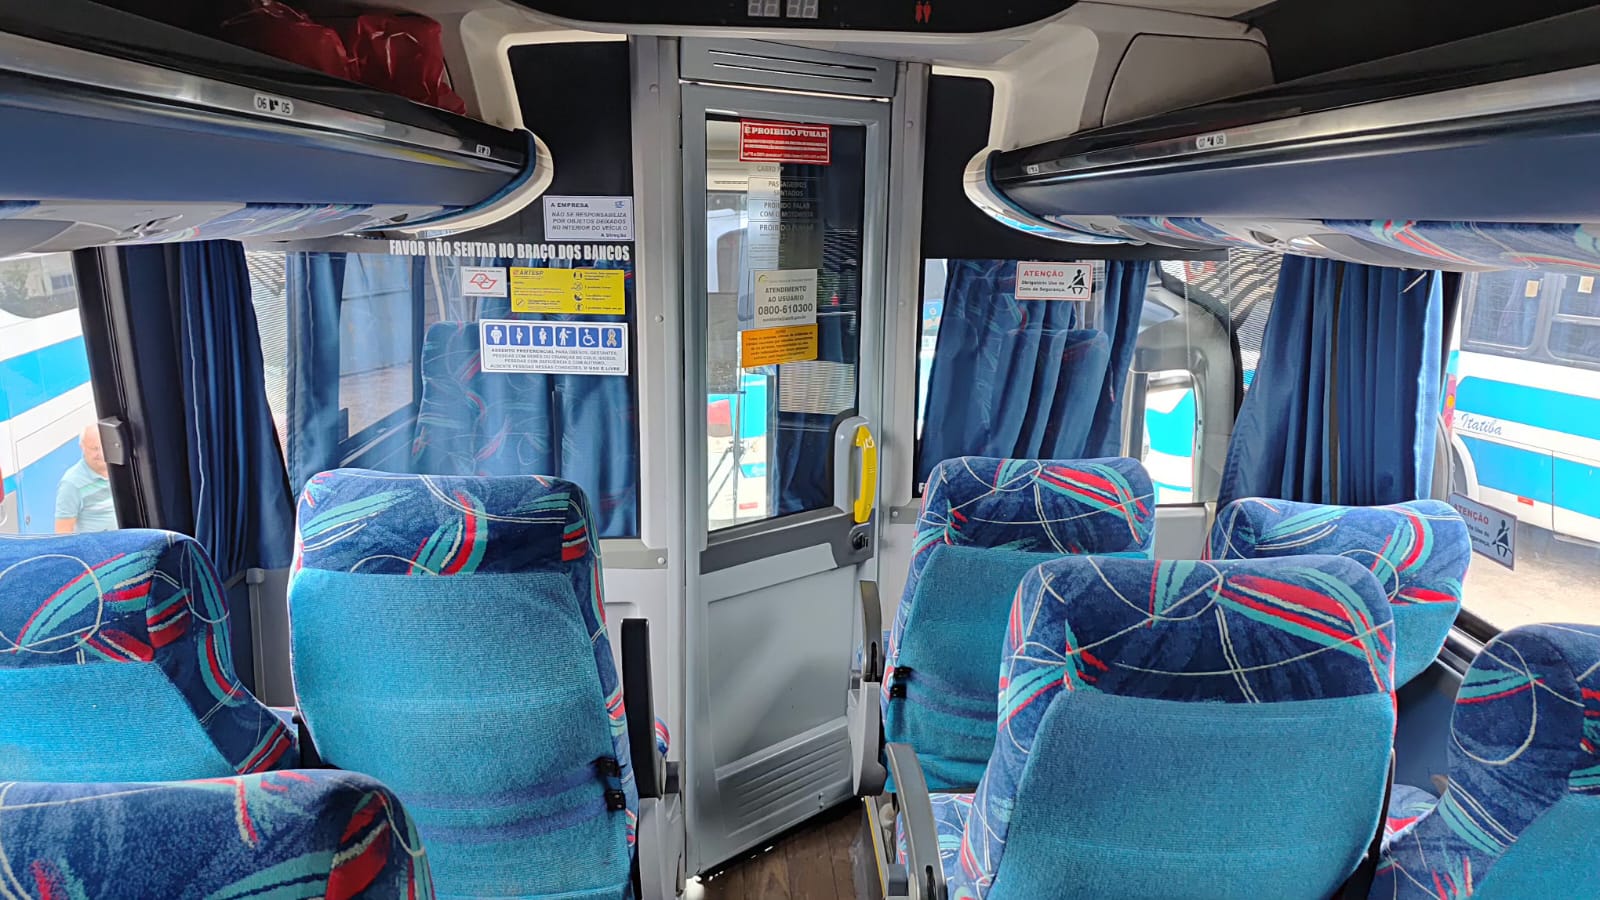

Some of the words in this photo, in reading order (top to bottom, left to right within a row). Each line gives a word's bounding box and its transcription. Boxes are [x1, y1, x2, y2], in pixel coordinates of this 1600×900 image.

[257, 97, 267, 109] 06
[744, 125, 751, 134] É
[752, 127, 796, 136] PROIBIDO
[797, 129, 827, 137] FUMAR
[389, 240, 426, 256] FAVOR
[428, 238, 451, 257] NÃO
[453, 241, 497, 258] SENTAR
[499, 242, 515, 258] NO
[517, 243, 556, 262] BRAÇO
[558, 244, 581, 260] DOS
[584, 244, 630, 261] BANCOS
[1023, 269, 1064, 278] ATENÇÃO
[758, 303, 813, 315] 0800-610300
[1461, 413, 1503, 436] Itatiba
